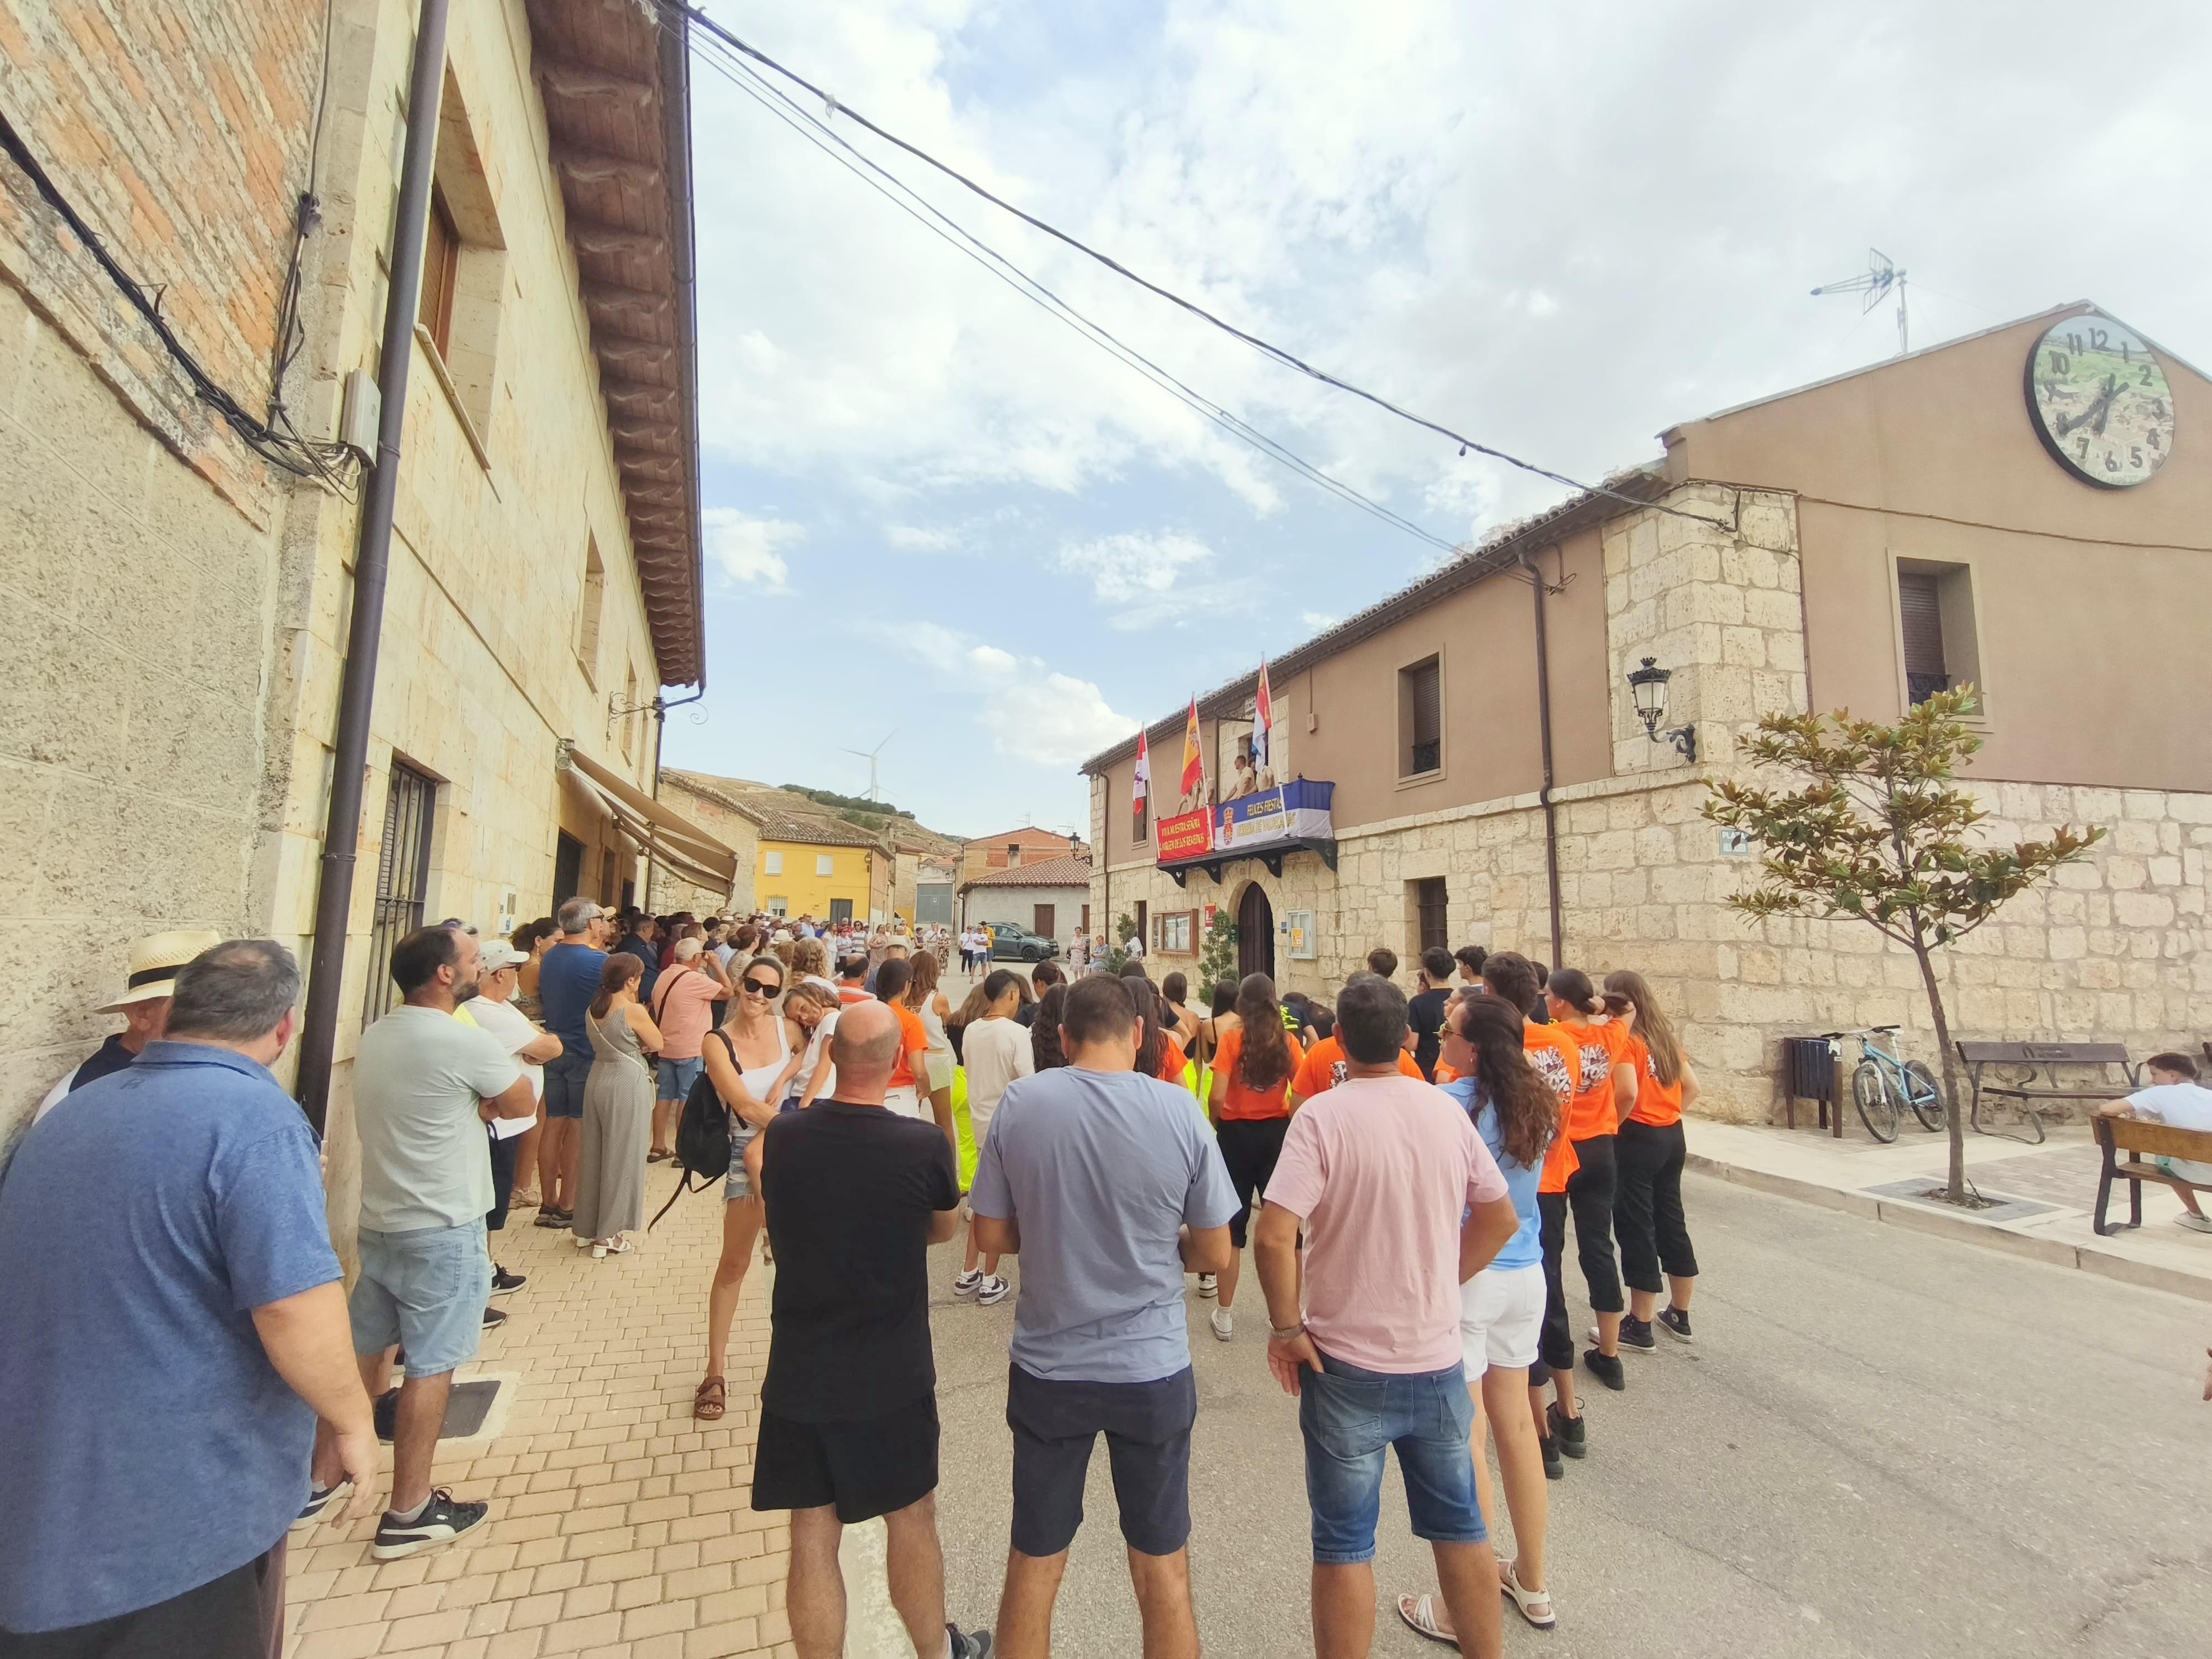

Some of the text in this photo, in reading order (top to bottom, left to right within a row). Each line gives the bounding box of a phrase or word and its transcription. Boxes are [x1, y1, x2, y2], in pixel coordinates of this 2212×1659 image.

[2066, 333, 2083, 356] 11
[2088, 327, 2110, 351] 12
[2048, 350, 2070, 375] 10
[2120, 341, 2130, 363] 1
[2138, 364, 2153, 387] 2
[2077, 436, 2090, 460] 7
[2146, 428, 2160, 450] 4
[2105, 451, 2117, 472] 6
[2130, 446, 2143, 468] 5
[1247, 801, 1264, 816] FELICES
